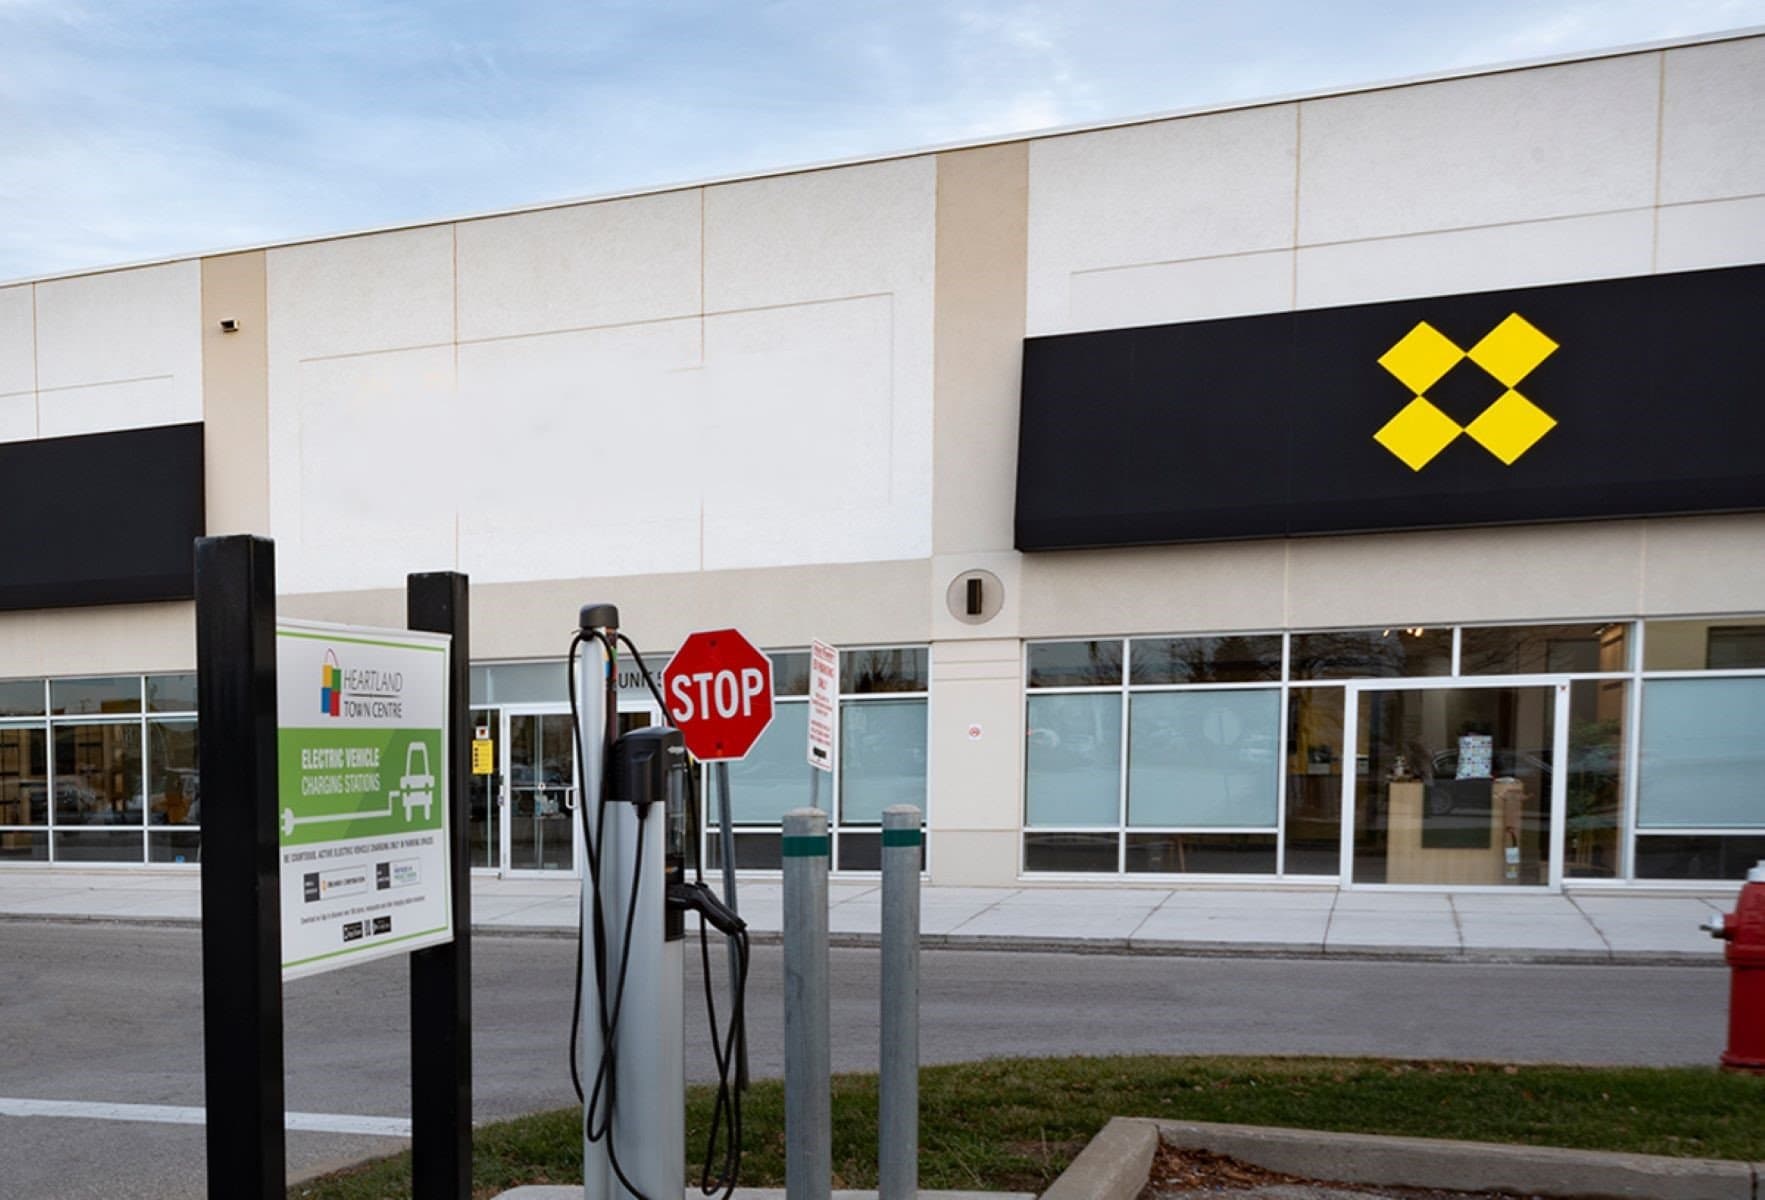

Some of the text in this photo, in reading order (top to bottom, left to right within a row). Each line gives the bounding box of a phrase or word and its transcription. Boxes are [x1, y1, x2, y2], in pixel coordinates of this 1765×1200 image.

[343, 670, 402, 692] HEARTLAND
[672, 667, 763, 723] STOP
[343, 701, 402, 719] TOWN CENTRE
[302, 748, 380, 768] ELECTRIC VEHICLE
[302, 773, 380, 796] CHARGING STATIONS
